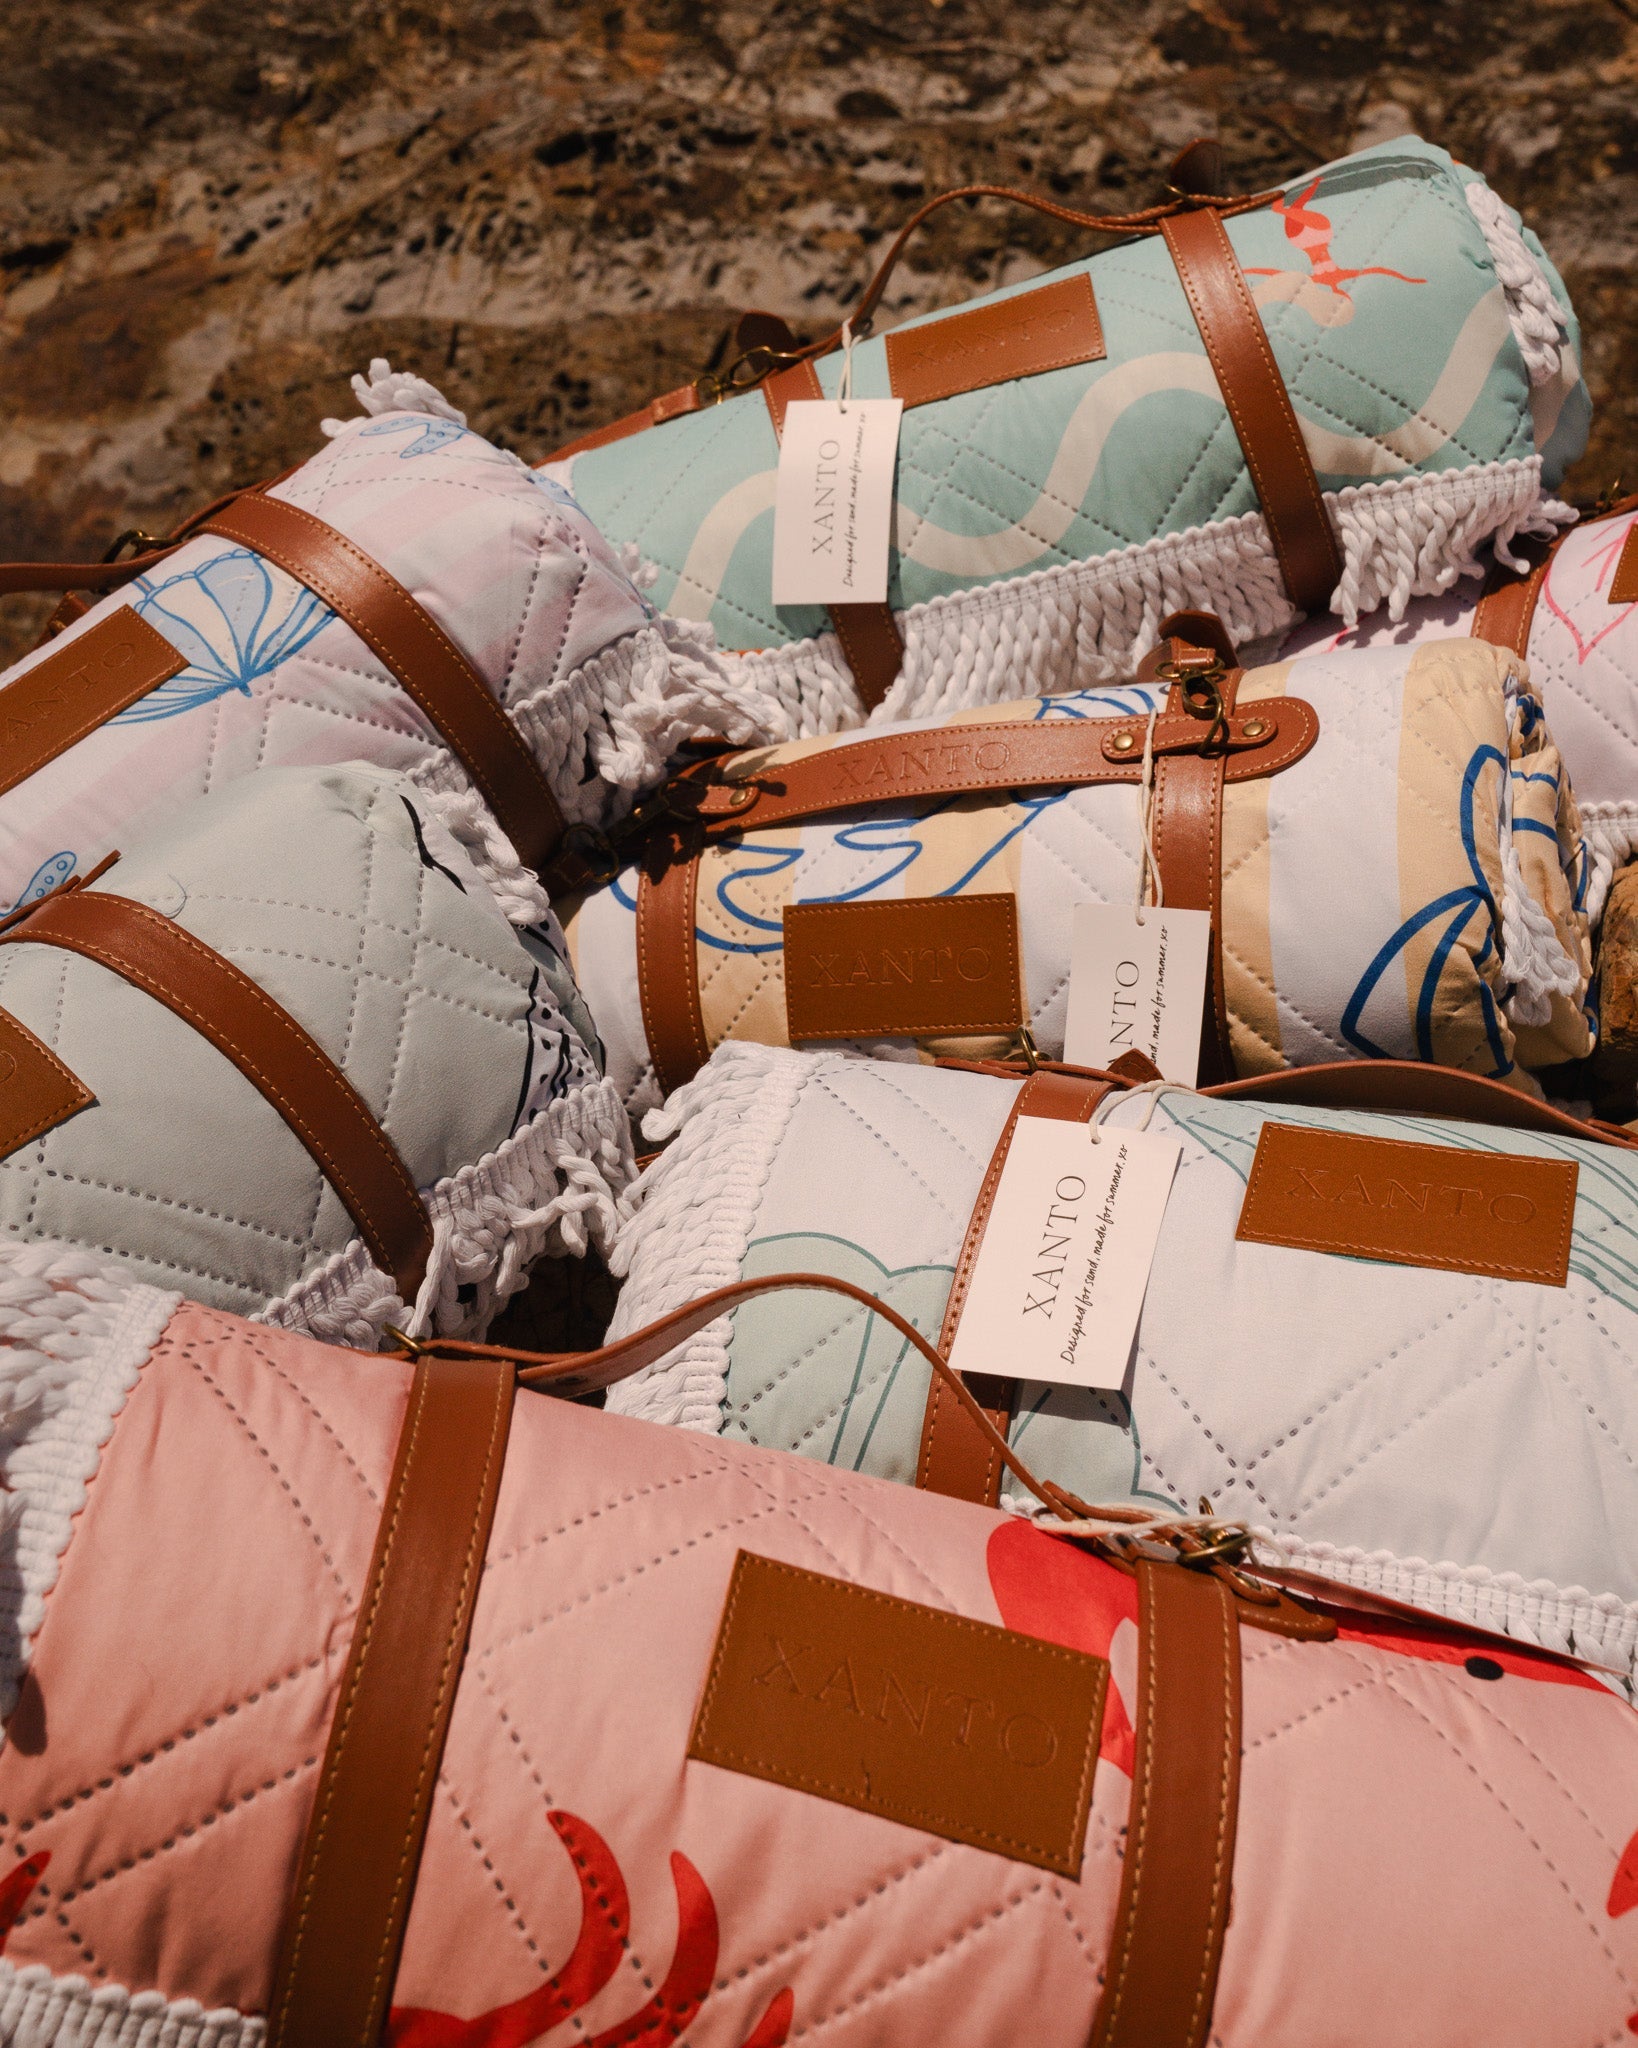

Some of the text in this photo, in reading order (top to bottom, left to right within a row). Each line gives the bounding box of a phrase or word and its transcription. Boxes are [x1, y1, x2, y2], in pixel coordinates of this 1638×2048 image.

[912, 308, 1075, 372] XANTO
[811, 439, 840, 555] XANTO
[0, 642, 135, 748] ANTO
[832, 741, 1011, 790] XANTO
[810, 947, 992, 987] XANTO
[1108, 961, 1139, 1064] NTO
[1148, 924, 1168, 1065] and, made for summer. xo
[1023, 1175, 1086, 1320] XANTO
[1283, 1166, 1537, 1225] XANTO
[1060, 1143, 1128, 1365] Designed for sand, made for summer. xo
[753, 1632, 1058, 1769] XANTO
